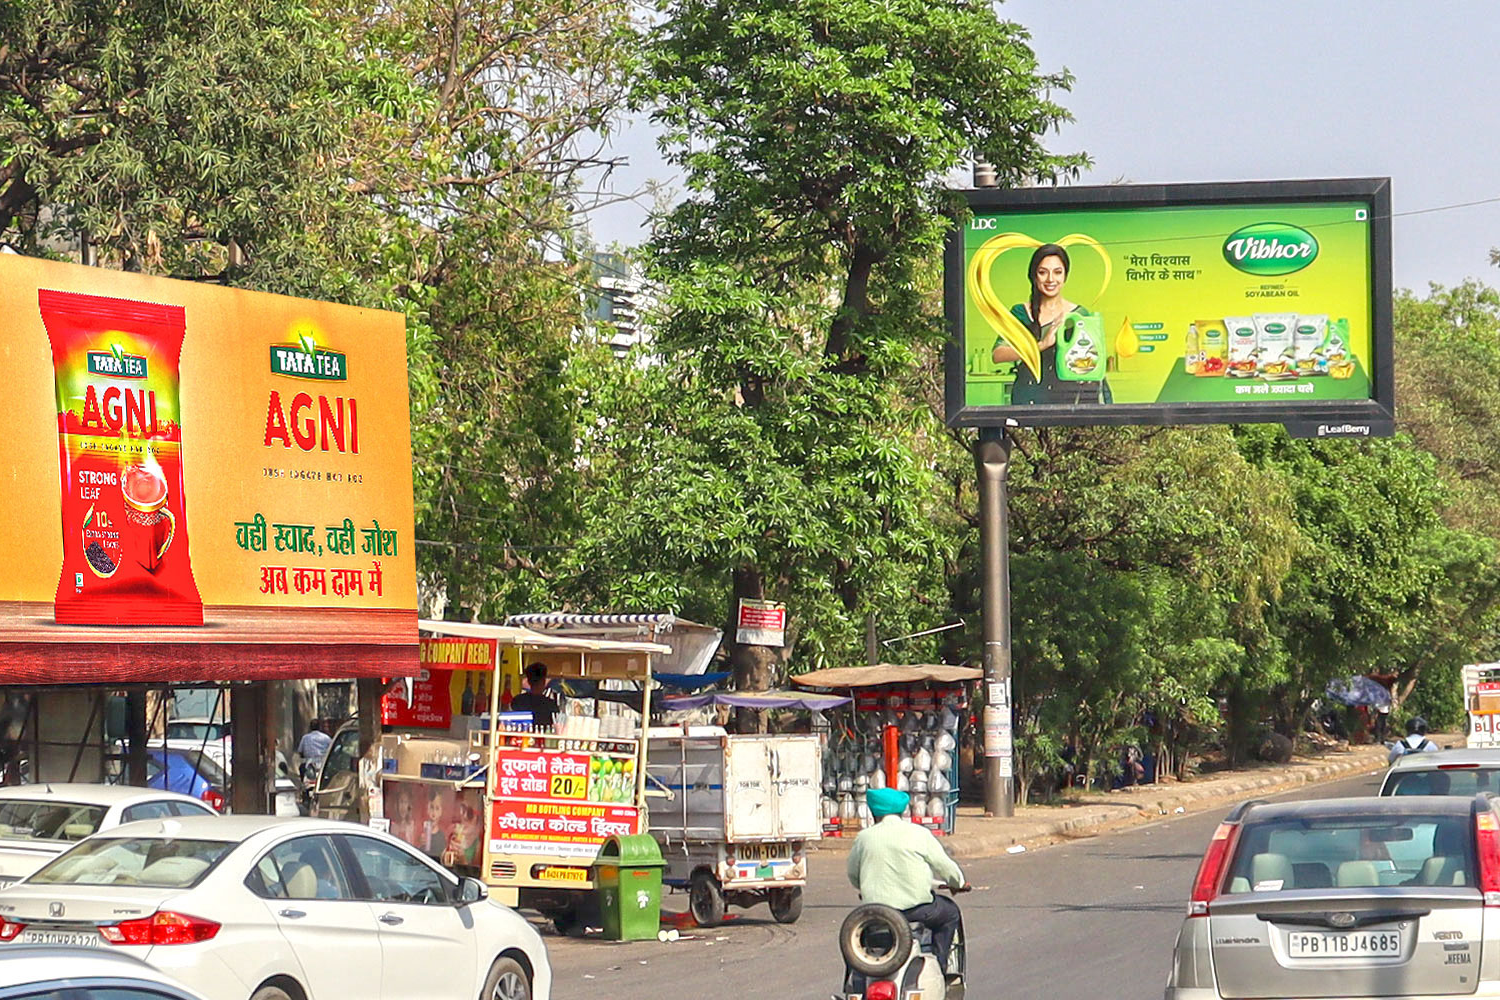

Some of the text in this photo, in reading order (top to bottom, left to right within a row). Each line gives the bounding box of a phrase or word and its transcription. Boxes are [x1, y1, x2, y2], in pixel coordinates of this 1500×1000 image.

[972, 218, 997, 230] LDC
[1226, 236, 1312, 260] Vibhor
[1150, 253, 1191, 266] विश्वास
[1126, 268, 1156, 281] विभोर
[1158, 268, 1170, 280] के
[92, 355, 143, 375] TATA TEA
[276, 350, 341, 377] TATA TEA
[81, 385, 157, 433] AGNI
[264, 390, 360, 454] AGNI
[1325, 424, 1369, 435] LeafBerry
[78, 470, 117, 486] STRONG
[80, 487, 101, 500] LEAF
[234, 513, 398, 557] वही स्वाद, वही जोश
[259, 561, 382, 598] अब कम दाम में
[428, 643, 467, 664] COMPANY
[501, 757, 586, 776] तूफानी लैमैन
[501, 774, 547, 795] दूध सोडा
[553, 777, 585, 795] 20/-
[539, 804, 571, 815] BOTTLING
[571, 806, 606, 817] COMPANY
[547, 815, 587, 832] कोल्ड
[1301, 935, 1398, 952] PB11BJ4685
